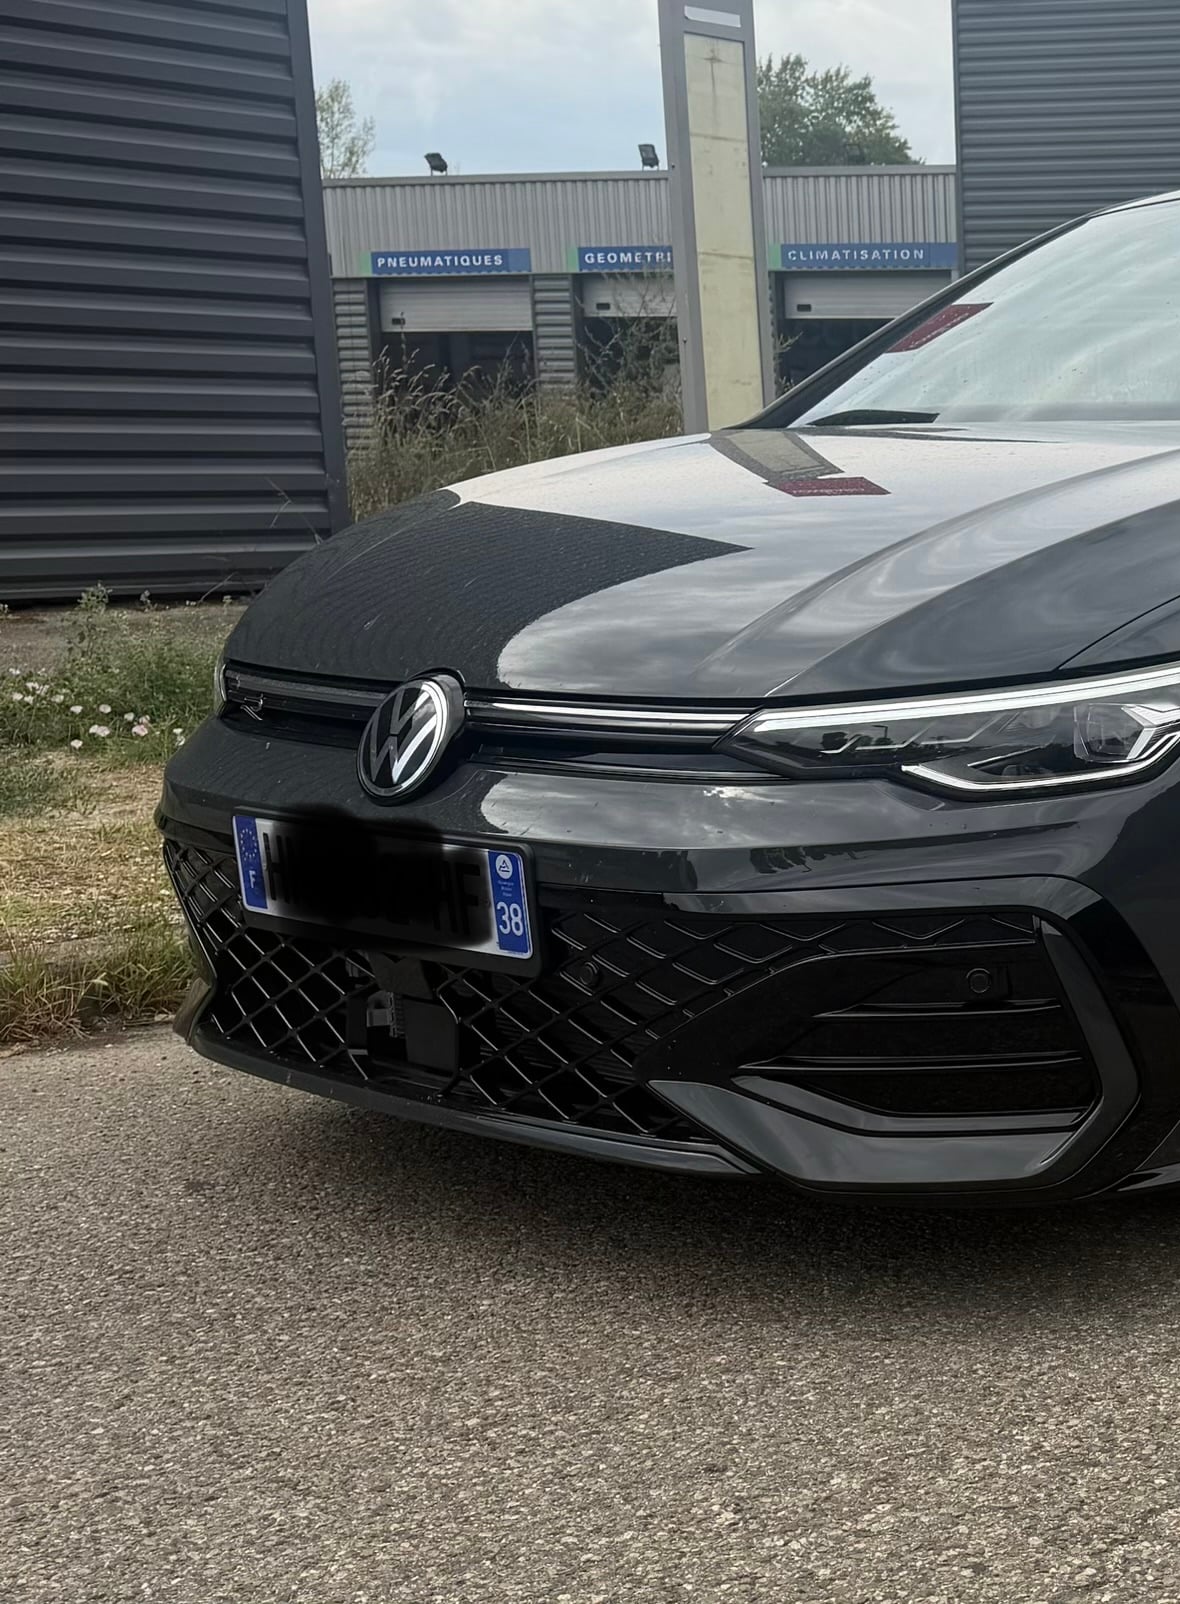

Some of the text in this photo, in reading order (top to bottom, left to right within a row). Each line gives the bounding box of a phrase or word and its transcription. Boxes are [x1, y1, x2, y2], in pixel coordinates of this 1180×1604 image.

[376, 254, 503, 268] PNEUMATIQUES
[584, 251, 672, 264] GEOMETRI
[787, 248, 925, 261] CLIMATISATION
[247, 869, 257, 890] F
[496, 901, 524, 937] 38
